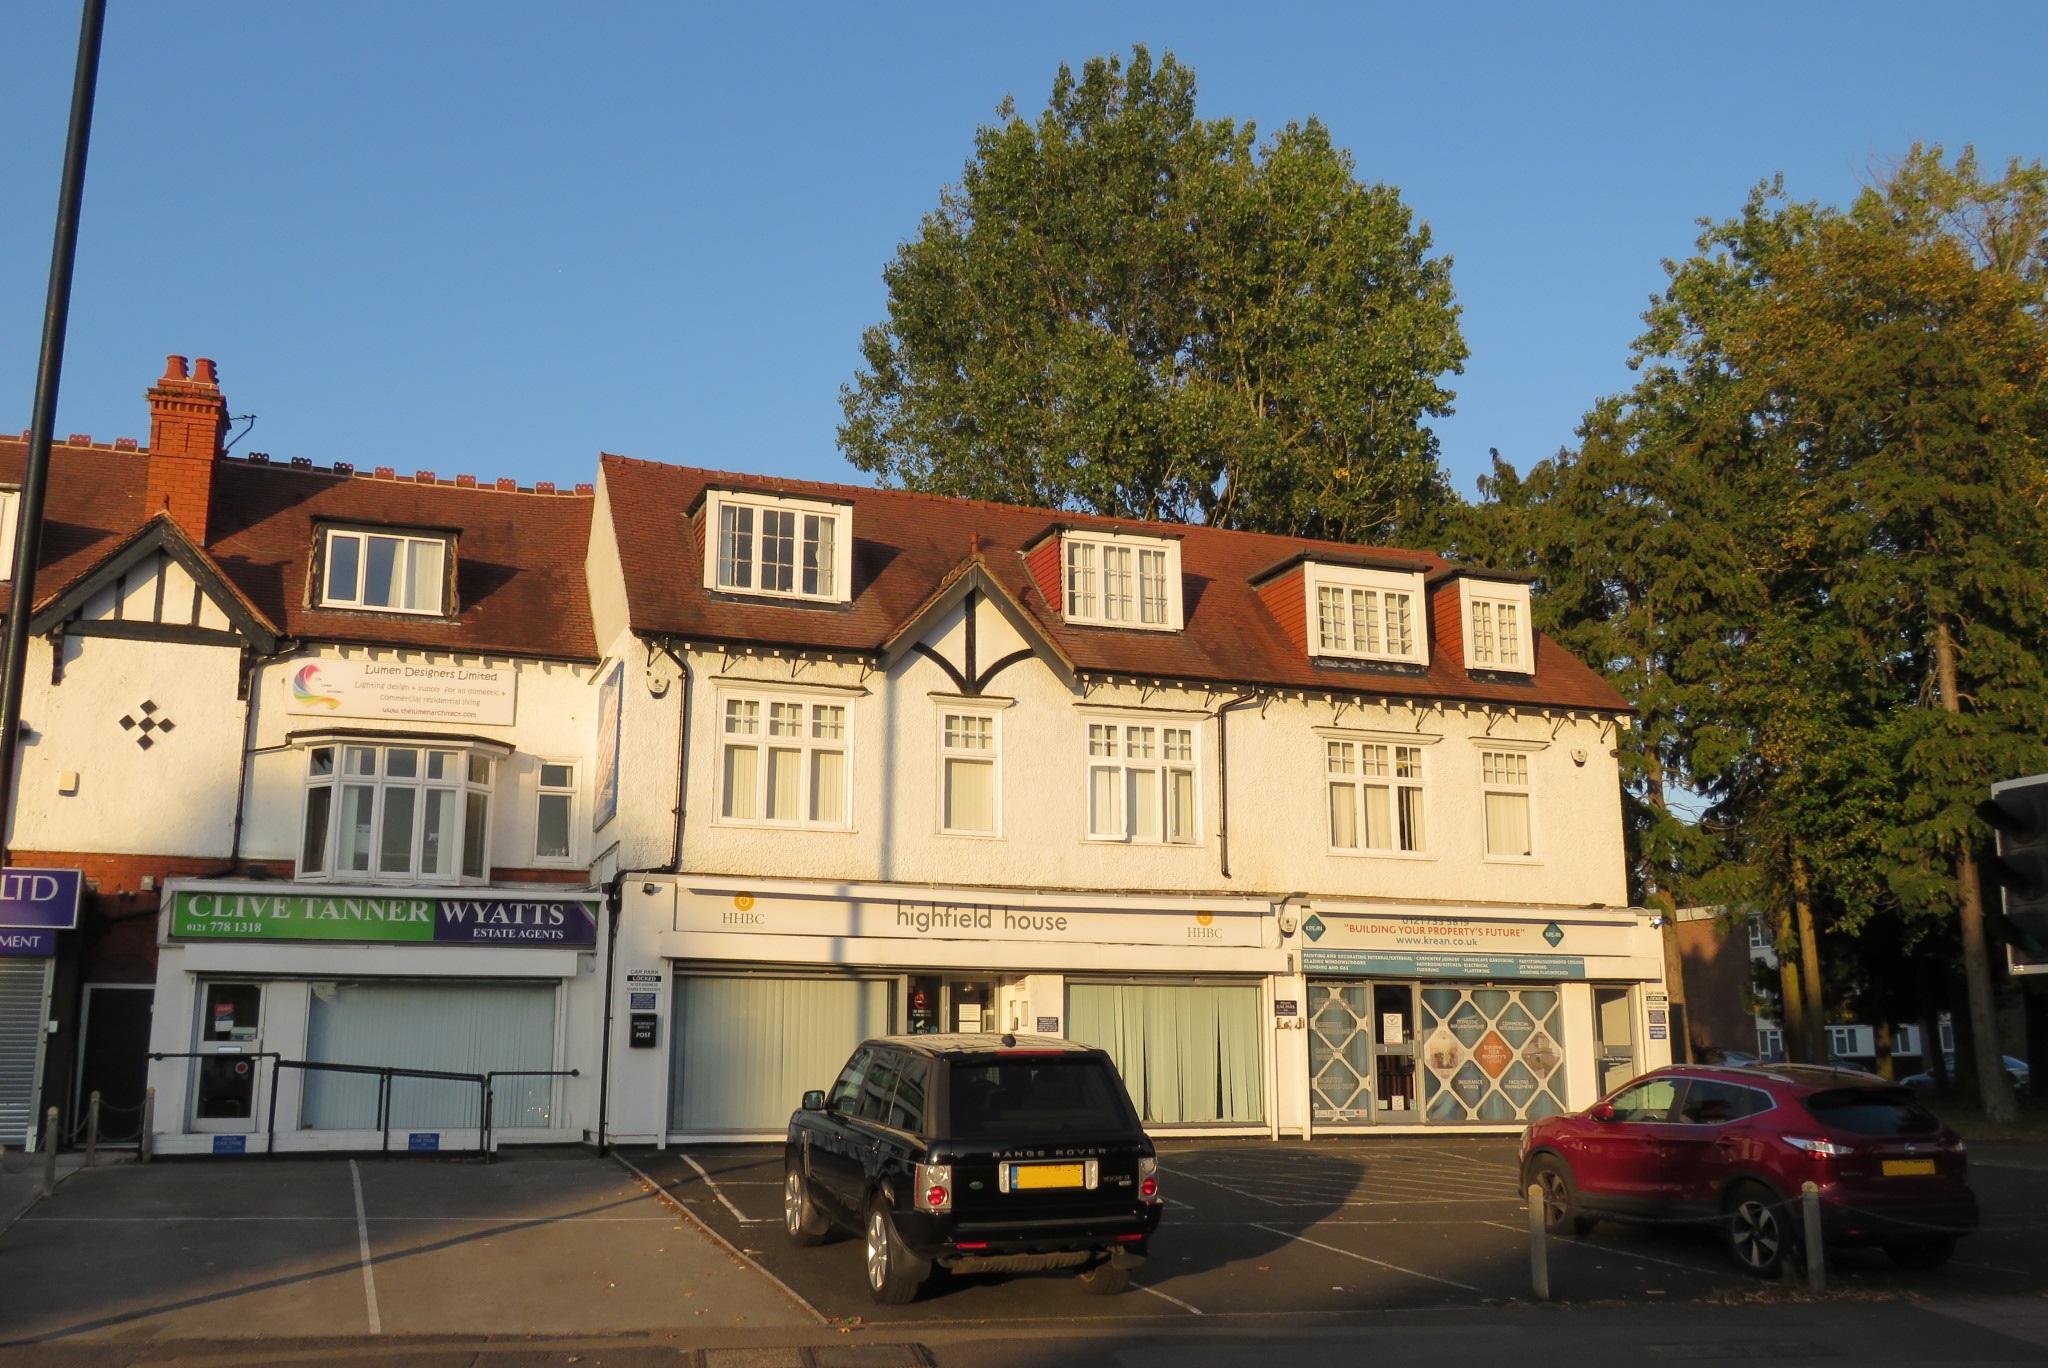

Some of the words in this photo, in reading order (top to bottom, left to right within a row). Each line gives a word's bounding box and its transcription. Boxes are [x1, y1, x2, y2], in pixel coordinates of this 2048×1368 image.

[364, 664, 402, 675] Lumen
[404, 666, 456, 679] Designers
[457, 669, 499, 681] Limited
[354, 681, 386, 691] Lighting
[386, 683, 410, 692] design
[467, 688, 500, 696] domestic
[380, 694, 422, 703] commercial
[423, 697, 463, 706] residential
[462, 698, 481, 707] living
[382, 707, 478, 718] www.thelumenarchitect.com
[0, 874, 59, 901] LTD
[187, 894, 292, 919] CLIVE
[295, 897, 431, 922] TANNER
[440, 901, 565, 925] WYATTS
[722, 912, 765, 925] HHBC
[896, 900, 992, 933] highfield
[1004, 904, 1068, 931] house
[186, 923, 206, 932] 0121
[210, 921, 232, 932] 778
[234, 922, 262, 933] 1318
[473, 928, 516, 939] ESTATE
[517, 929, 564, 939] AGENTS
[1186, 926, 1223, 939] HHBC
[1399, 925, 1426, 935] YOUR
[1427, 926, 1484, 937] PROPERTY'S
[1396, 936, 1478, 947] www.krean.co.uk
[992, 1150, 1045, 1158] RANGE
[1055, 1148, 1107, 1156] ROVER
